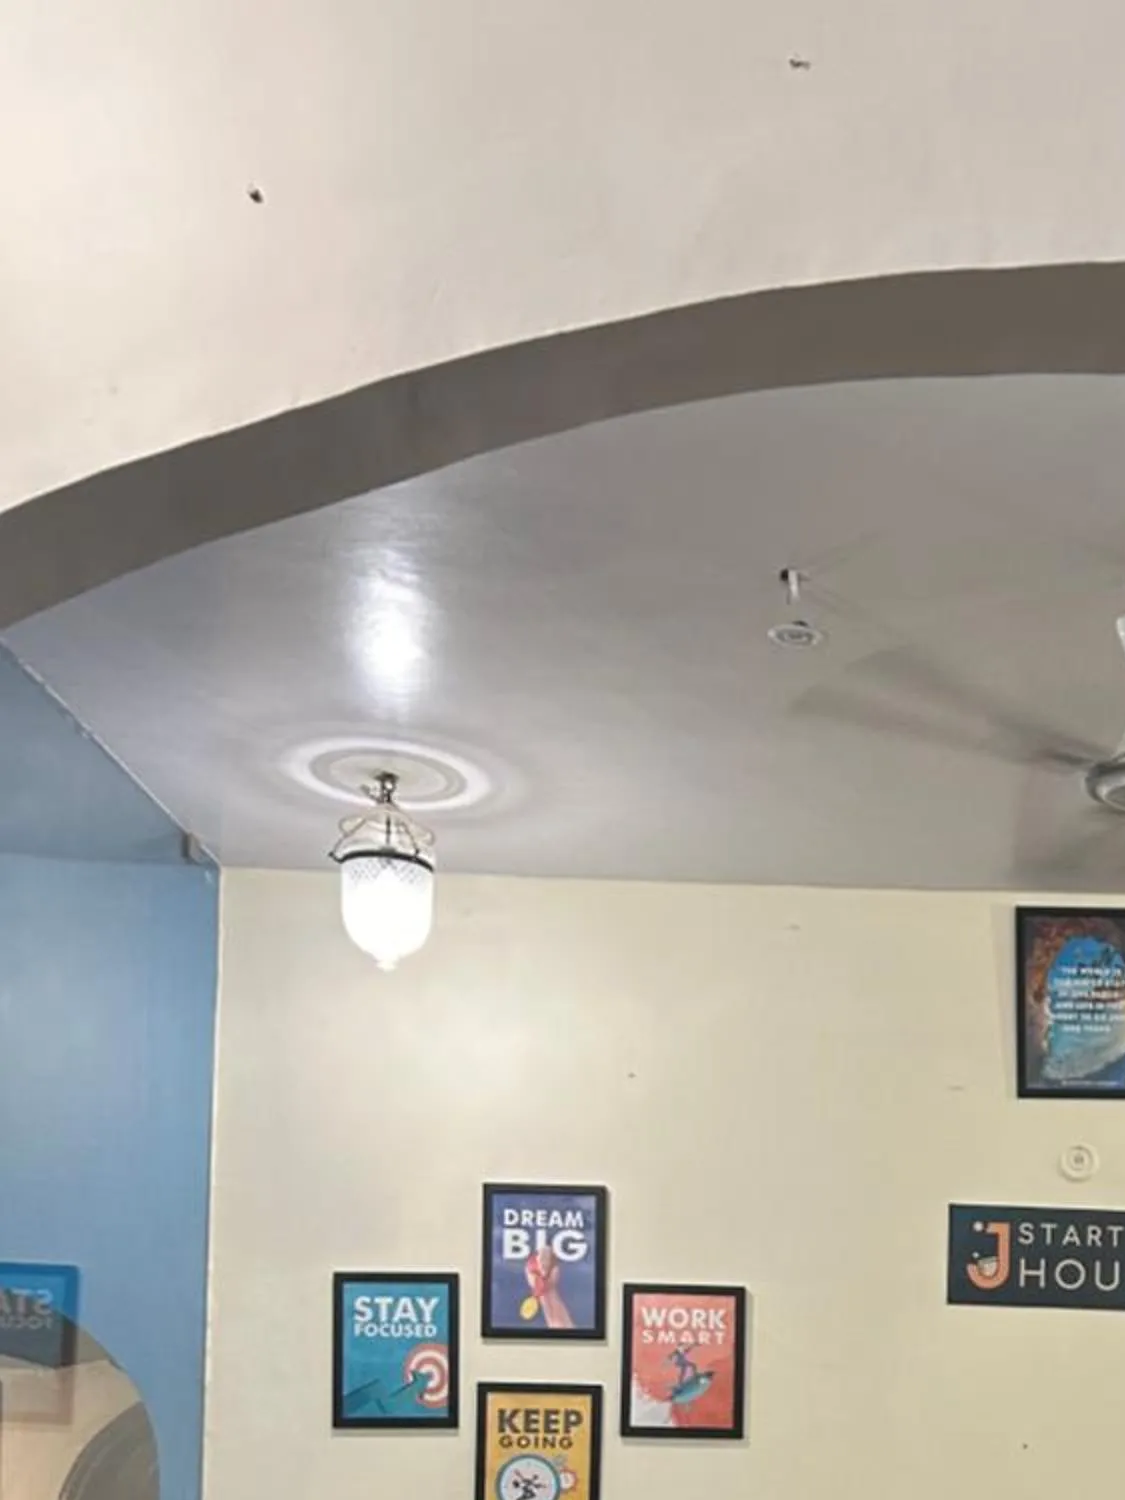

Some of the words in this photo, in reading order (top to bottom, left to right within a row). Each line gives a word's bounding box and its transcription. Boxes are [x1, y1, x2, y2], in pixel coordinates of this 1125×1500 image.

[503, 1208, 584, 1228] DREAM
[502, 1229, 588, 1261] BIG
[1018, 1222, 1125, 1248] START
[353, 1296, 440, 1322] STAY
[640, 1307, 727, 1331] WORK
[353, 1322, 438, 1338] FOCUSED
[641, 1330, 726, 1345] SMART
[497, 1408, 584, 1434] KEEP
[498, 1435, 574, 1451] GOING
